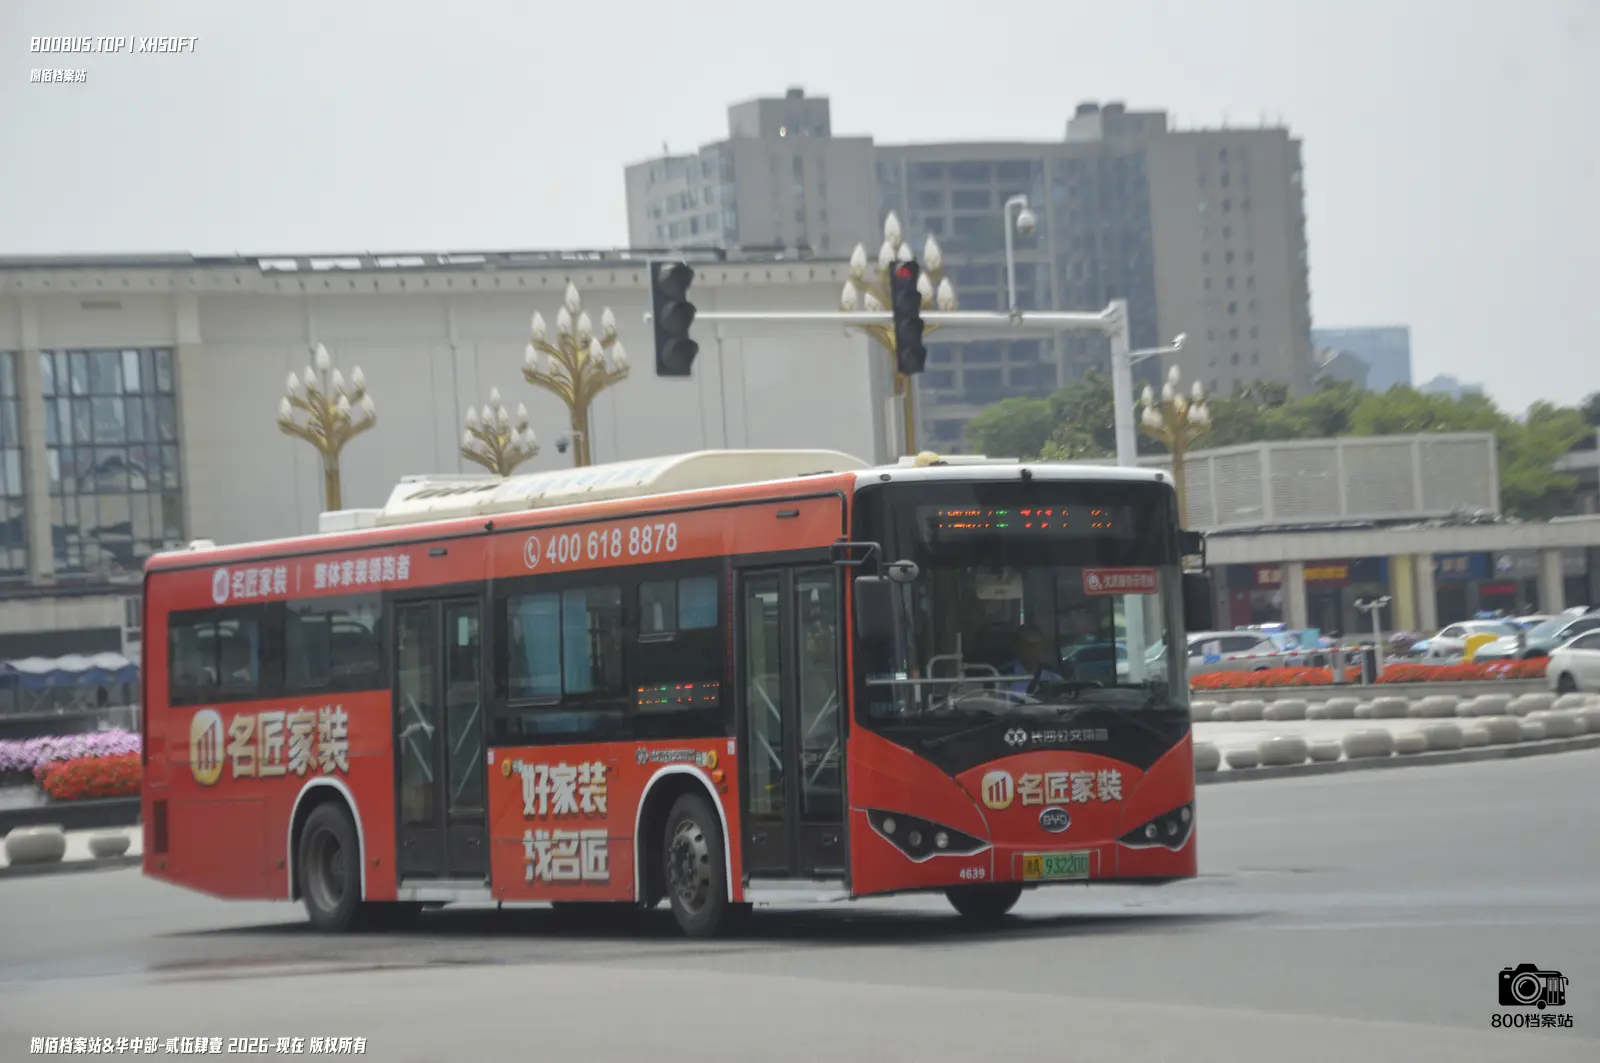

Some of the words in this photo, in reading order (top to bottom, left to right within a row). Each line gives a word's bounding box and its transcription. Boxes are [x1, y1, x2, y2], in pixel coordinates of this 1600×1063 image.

[546, 532, 582, 564] 400
[587, 528, 622, 559] 618
[628, 522, 678, 557] 8878
[521, 761, 607, 816] 好家装
[1042, 814, 1068, 826] BYD
[523, 829, 609, 881] 找名匠
[959, 867, 985, 879] 4639
